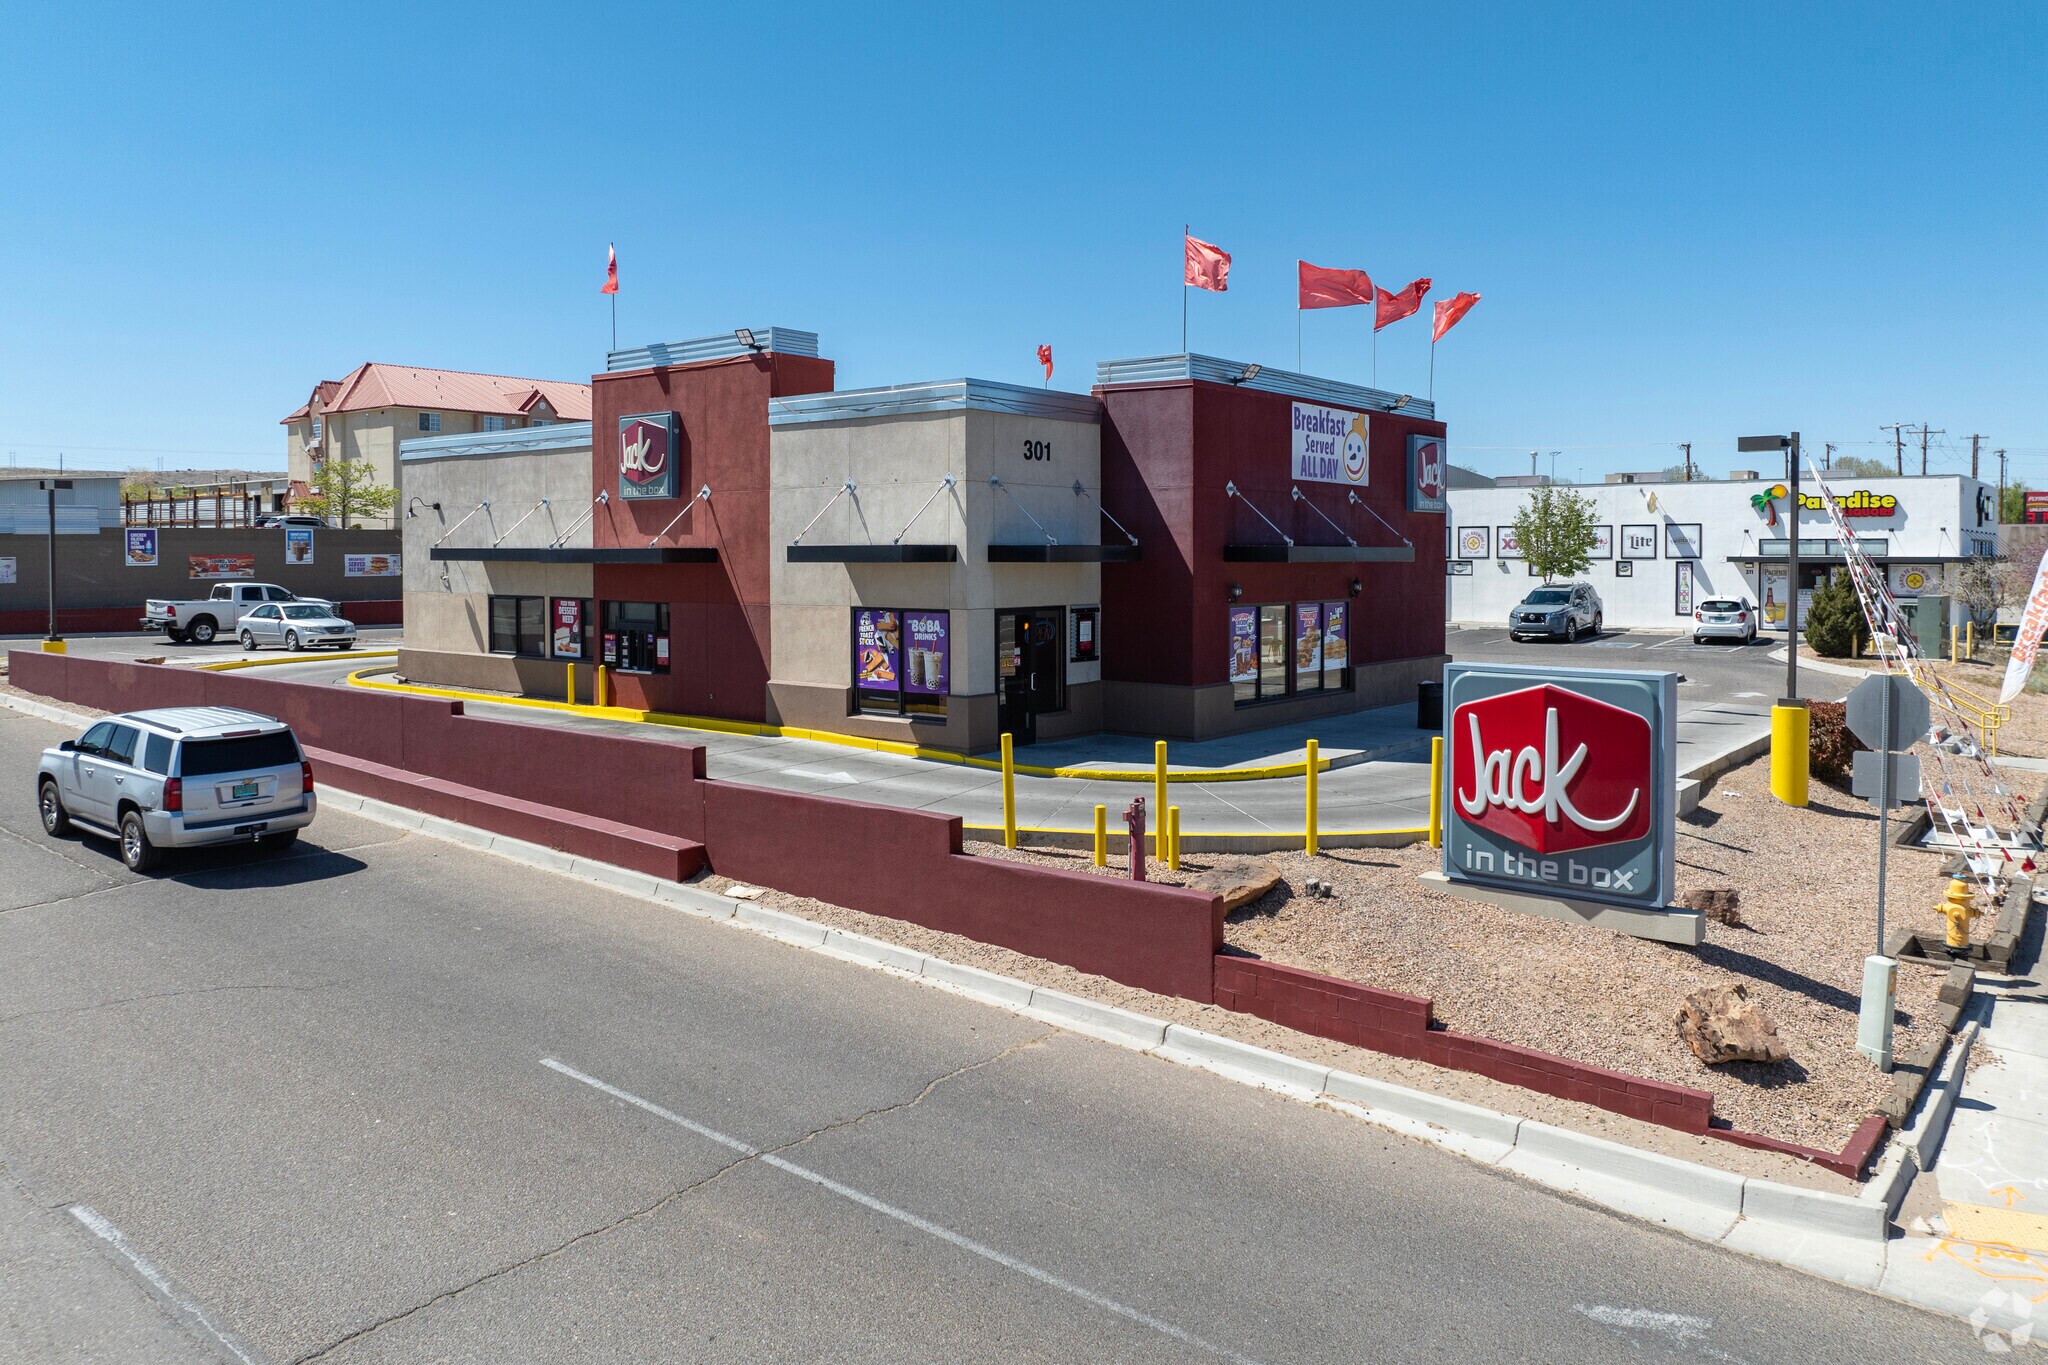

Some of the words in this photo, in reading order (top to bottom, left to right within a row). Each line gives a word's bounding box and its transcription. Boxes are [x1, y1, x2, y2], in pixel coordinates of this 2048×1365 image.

[1293, 406, 1346, 437] Breakfast
[621, 426, 664, 474] Jack
[1023, 439, 1051, 462] 301
[1305, 434, 1335, 456] Served
[1300, 455, 1318, 478] ALL
[1319, 457, 1339, 480] DAY
[1419, 448, 1446, 489] Jack
[623, 485, 632, 496] in
[632, 485, 647, 495] the
[648, 485, 665, 495] box
[1419, 499, 1425, 508] in
[1424, 500, 1434, 509] the
[1434, 501, 1444, 510] box
[1629, 535, 1652, 550] Lite
[558, 606, 578, 615] DESSERT
[562, 615, 574, 623] NEED
[911, 619, 940, 632] BOBA
[914, 633, 937, 641] DRINKS
[1458, 707, 1640, 832] Jack
[1466, 843, 1495, 872] in
[1503, 850, 1559, 881] the
[1568, 858, 1636, 892] box
